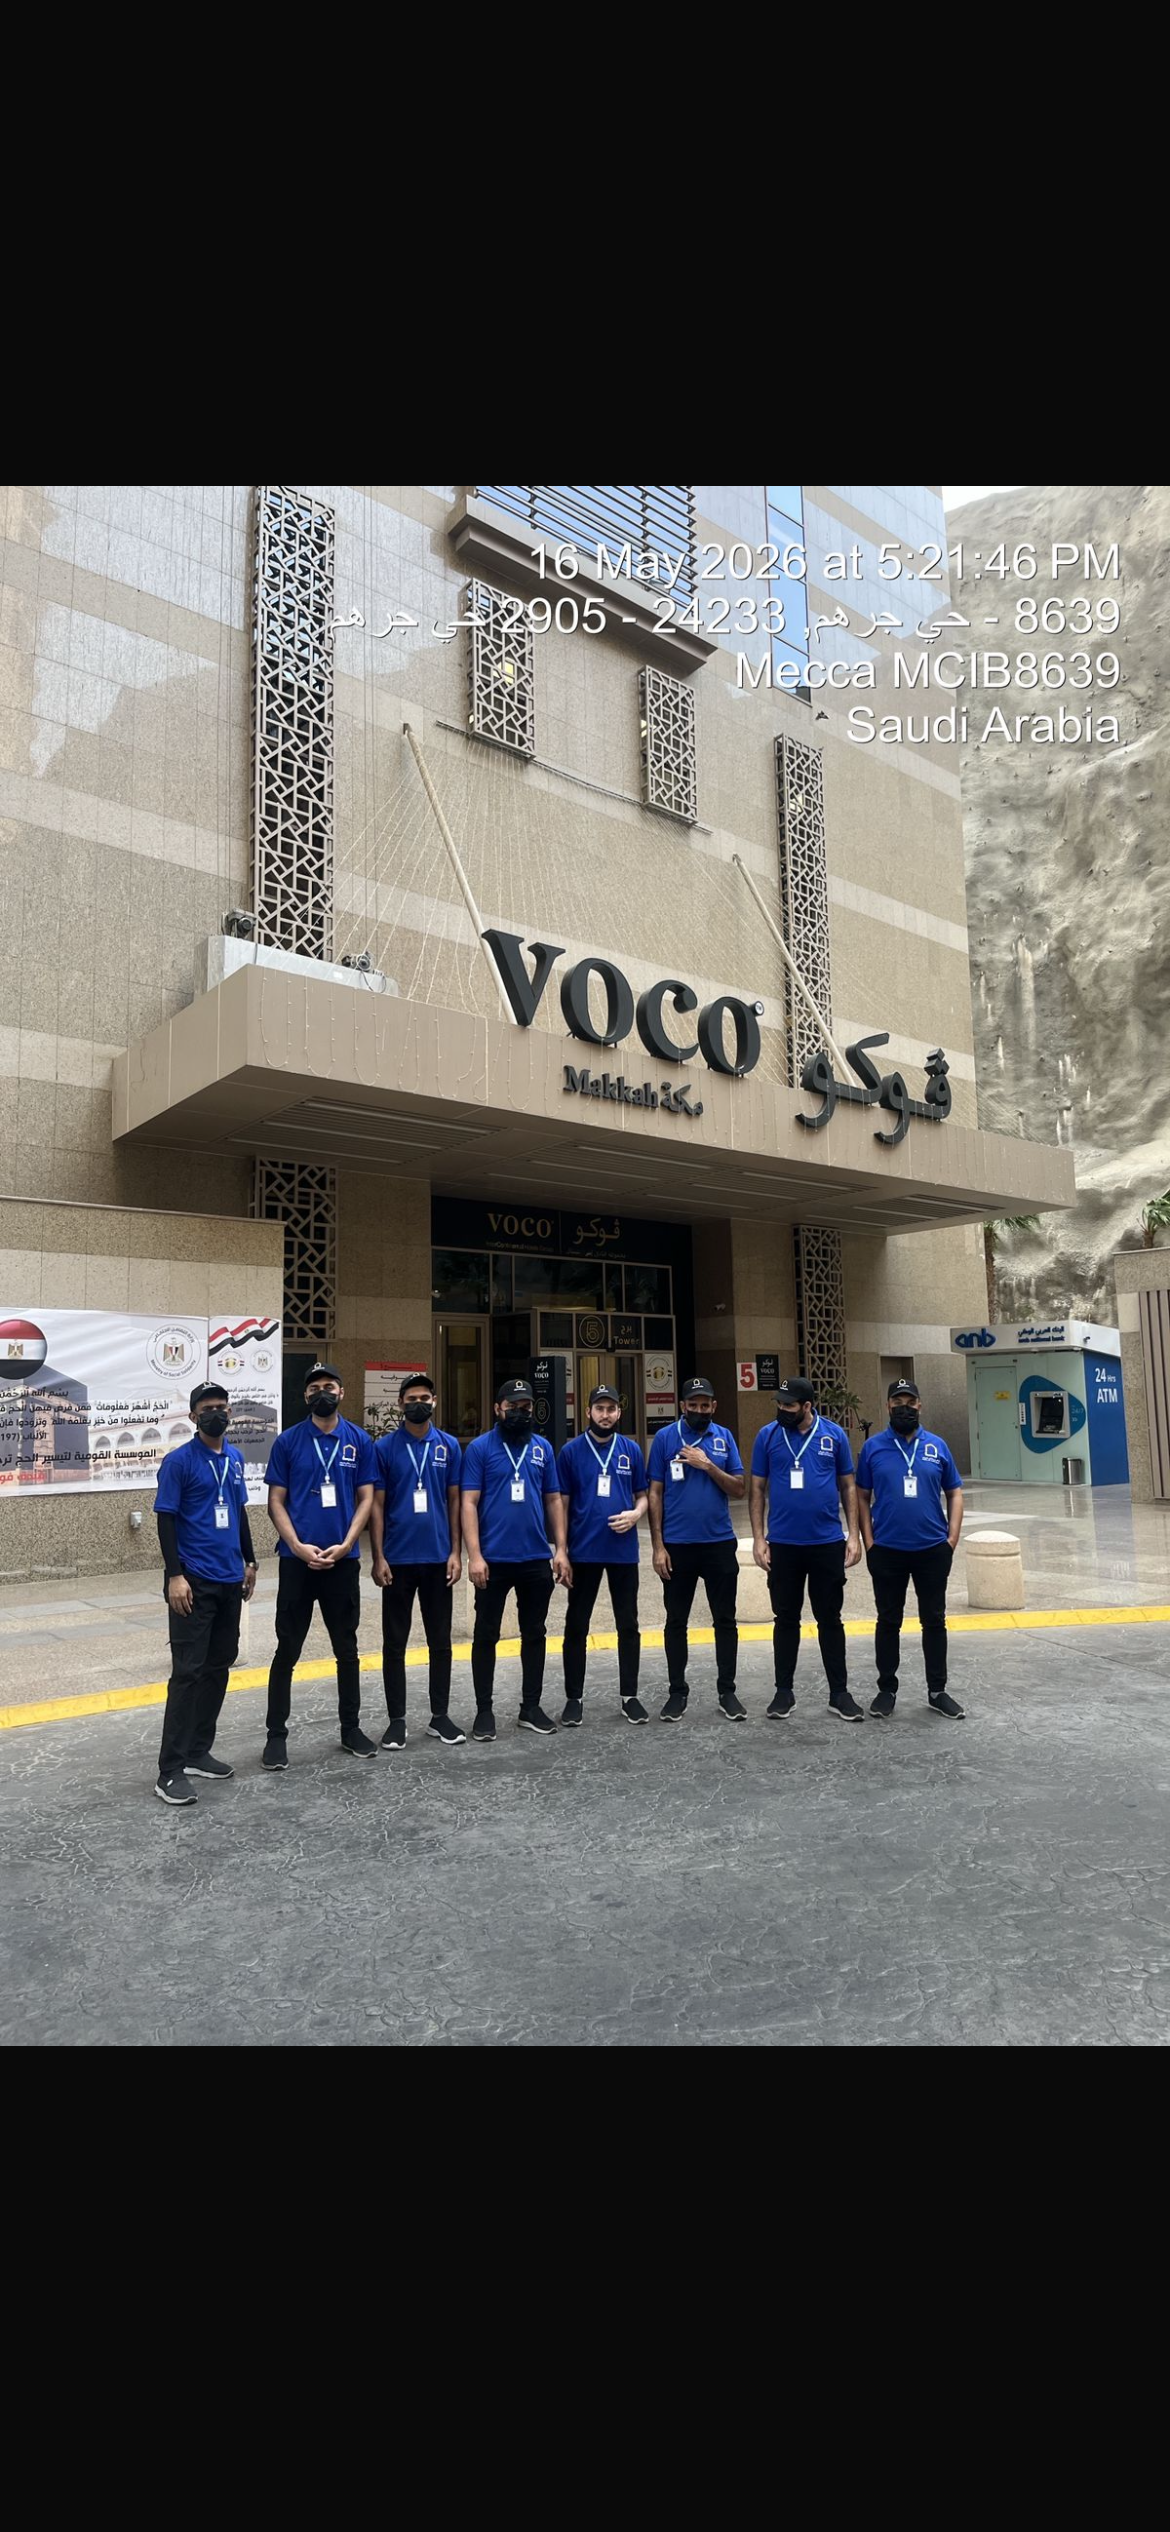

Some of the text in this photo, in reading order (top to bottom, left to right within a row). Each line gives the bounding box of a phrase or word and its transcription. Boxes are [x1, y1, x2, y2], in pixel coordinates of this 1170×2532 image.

[563, 1064, 704, 1116] Makkah مكة
[613, 1335, 640, 1345] Tower
[954, 1328, 997, 1349] anb
[740, 1363, 755, 1389] 5
[1095, 1367, 1107, 1383] 24
[1097, 1388, 1118, 1404] ATM
[15, 1453, 39, 1466] الحج
[74, 1450, 111, 1463] القومية
